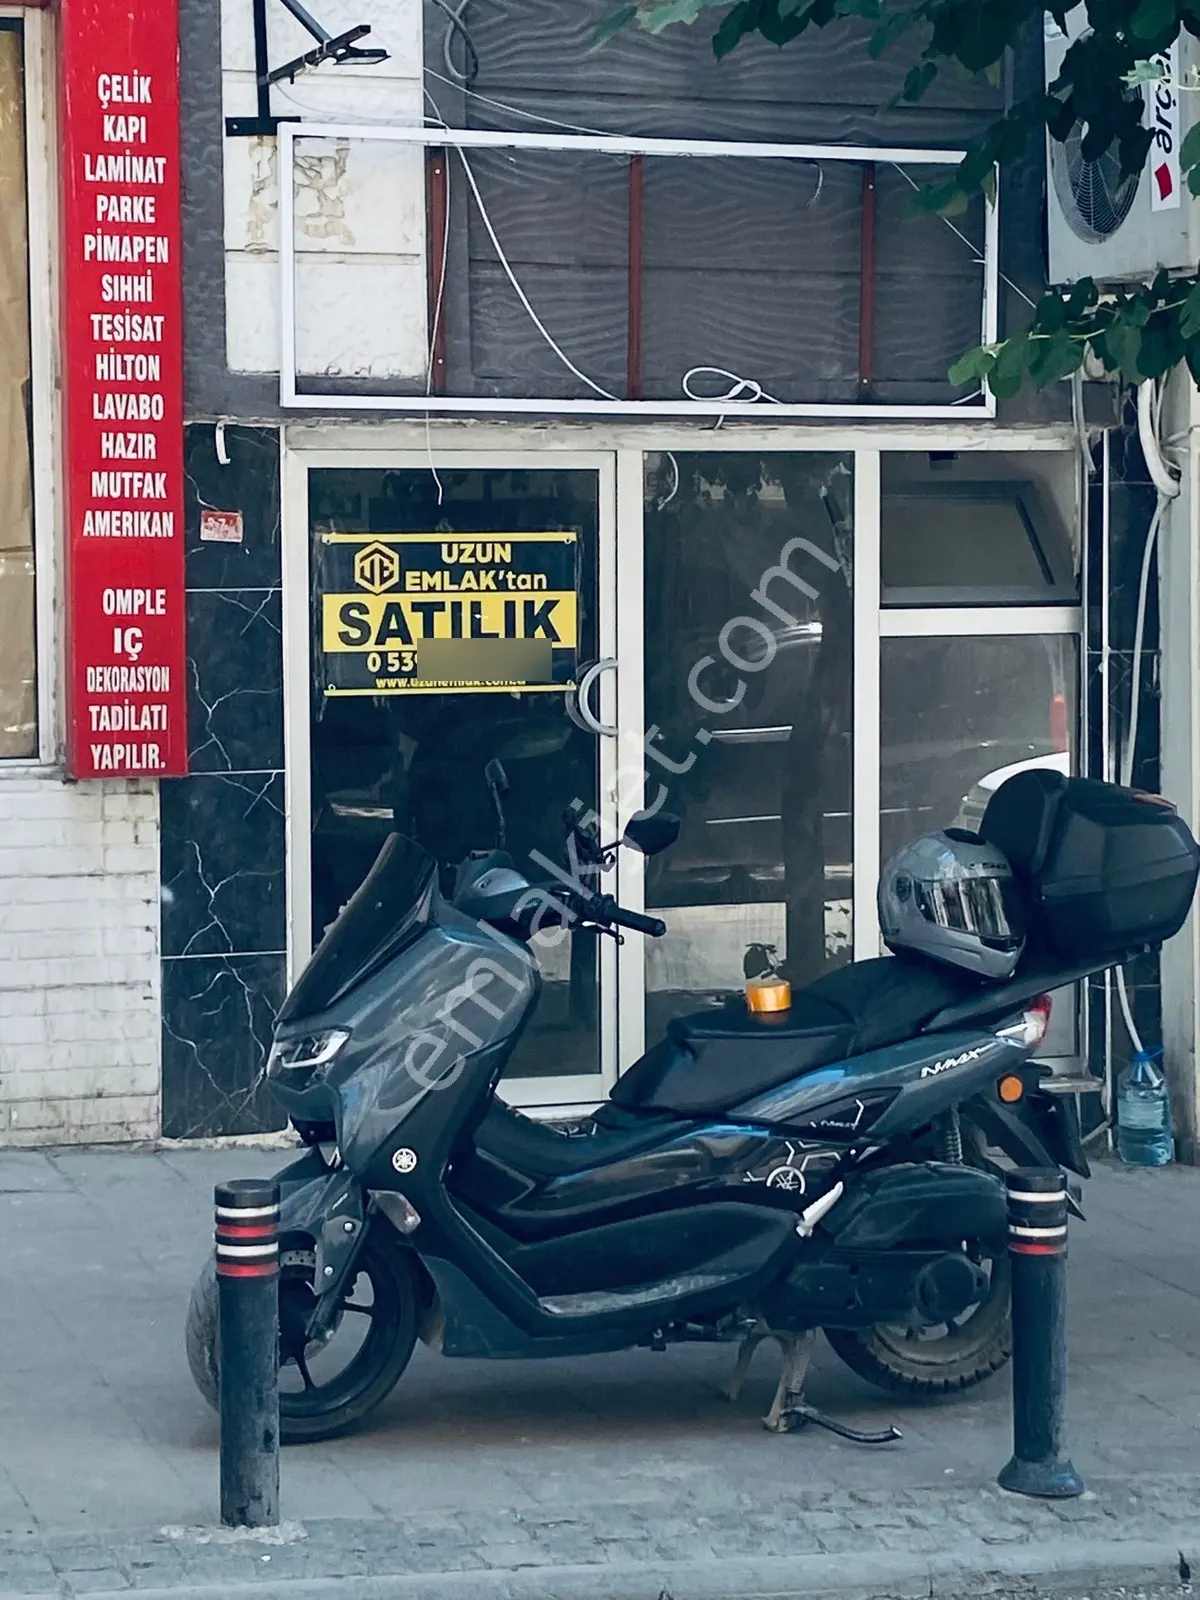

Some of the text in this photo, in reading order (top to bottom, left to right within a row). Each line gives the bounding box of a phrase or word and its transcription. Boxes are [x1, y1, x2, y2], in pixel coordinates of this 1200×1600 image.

[97, 69, 152, 109] ÇELİK
[103, 115, 147, 143] KAPI
[84, 150, 167, 184] LAMİNAT
[96, 195, 156, 223] PARKE
[83, 228, 169, 263] PİMAPEN
[101, 269, 153, 303] SIHHİ
[90, 308, 165, 342] TESİSAT
[95, 347, 160, 382] HİLTON
[93, 394, 164, 421] LAVABO
[101, 432, 157, 460] HAZIR
[91, 471, 167, 499] MUTFAK
[82, 510, 174, 538] AMERIKAN
[441, 543, 512, 564] UZUN
[405, 570, 548, 592] EMLAK'tan
[102, 588, 166, 615] OMPLE
[338, 599, 562, 646] SATILIK
[113, 627, 143, 661] IÇ
[367, 651, 418, 673] 0 53
[86, 666, 170, 693] DEKORASYON
[88, 698, 168, 732] TADİLATI
[90, 743, 167, 770] YAPILIR.
